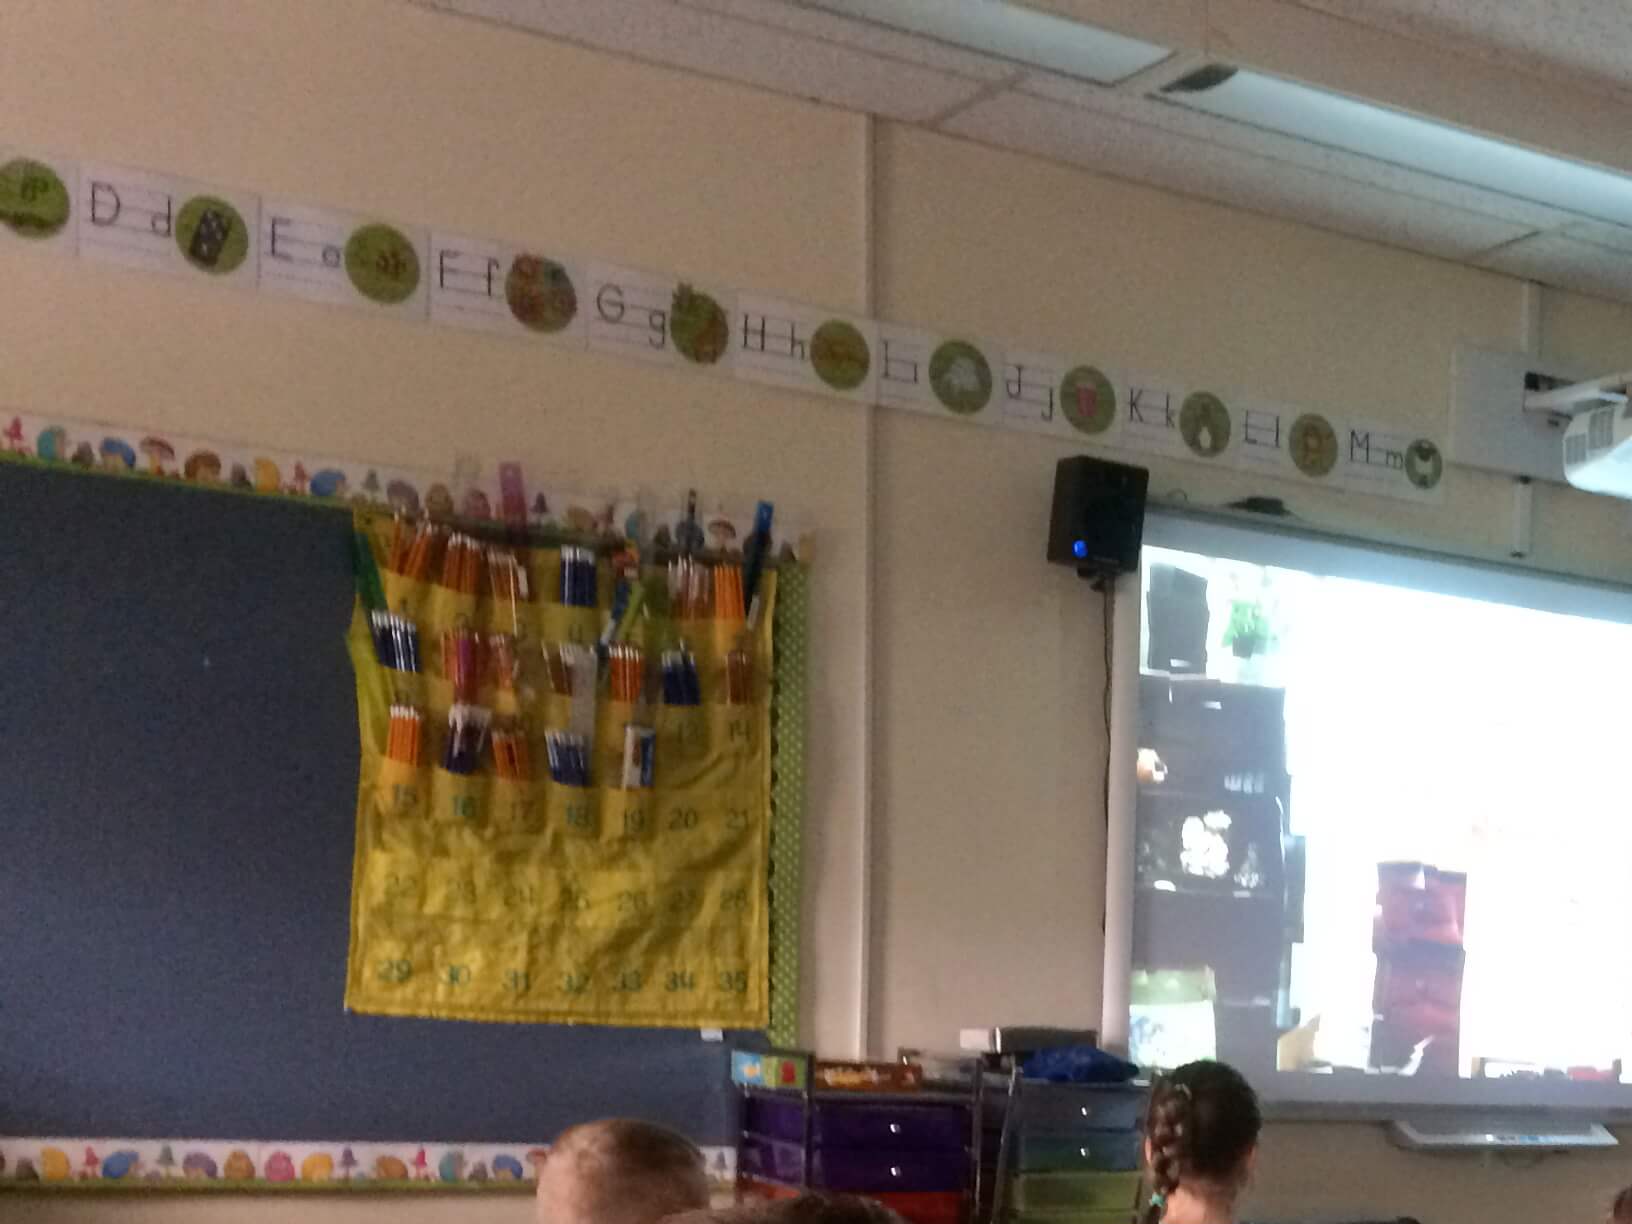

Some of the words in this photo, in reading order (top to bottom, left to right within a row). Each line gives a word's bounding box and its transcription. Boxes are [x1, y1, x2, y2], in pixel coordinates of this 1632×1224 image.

[89, 181, 122, 227] D
[151, 195, 173, 238] d
[269, 217, 293, 261] E
[439, 249, 461, 290] F
[596, 283, 626, 323] G
[647, 310, 667, 348] g
[742, 313, 768, 353] H
[790, 324, 807, 361] h
[1006, 365, 1023, 399] J
[1128, 388, 1145, 422] K
[1164, 393, 1178, 430] k
[1243, 410, 1259, 446] L
[1349, 431, 1369, 463] M
